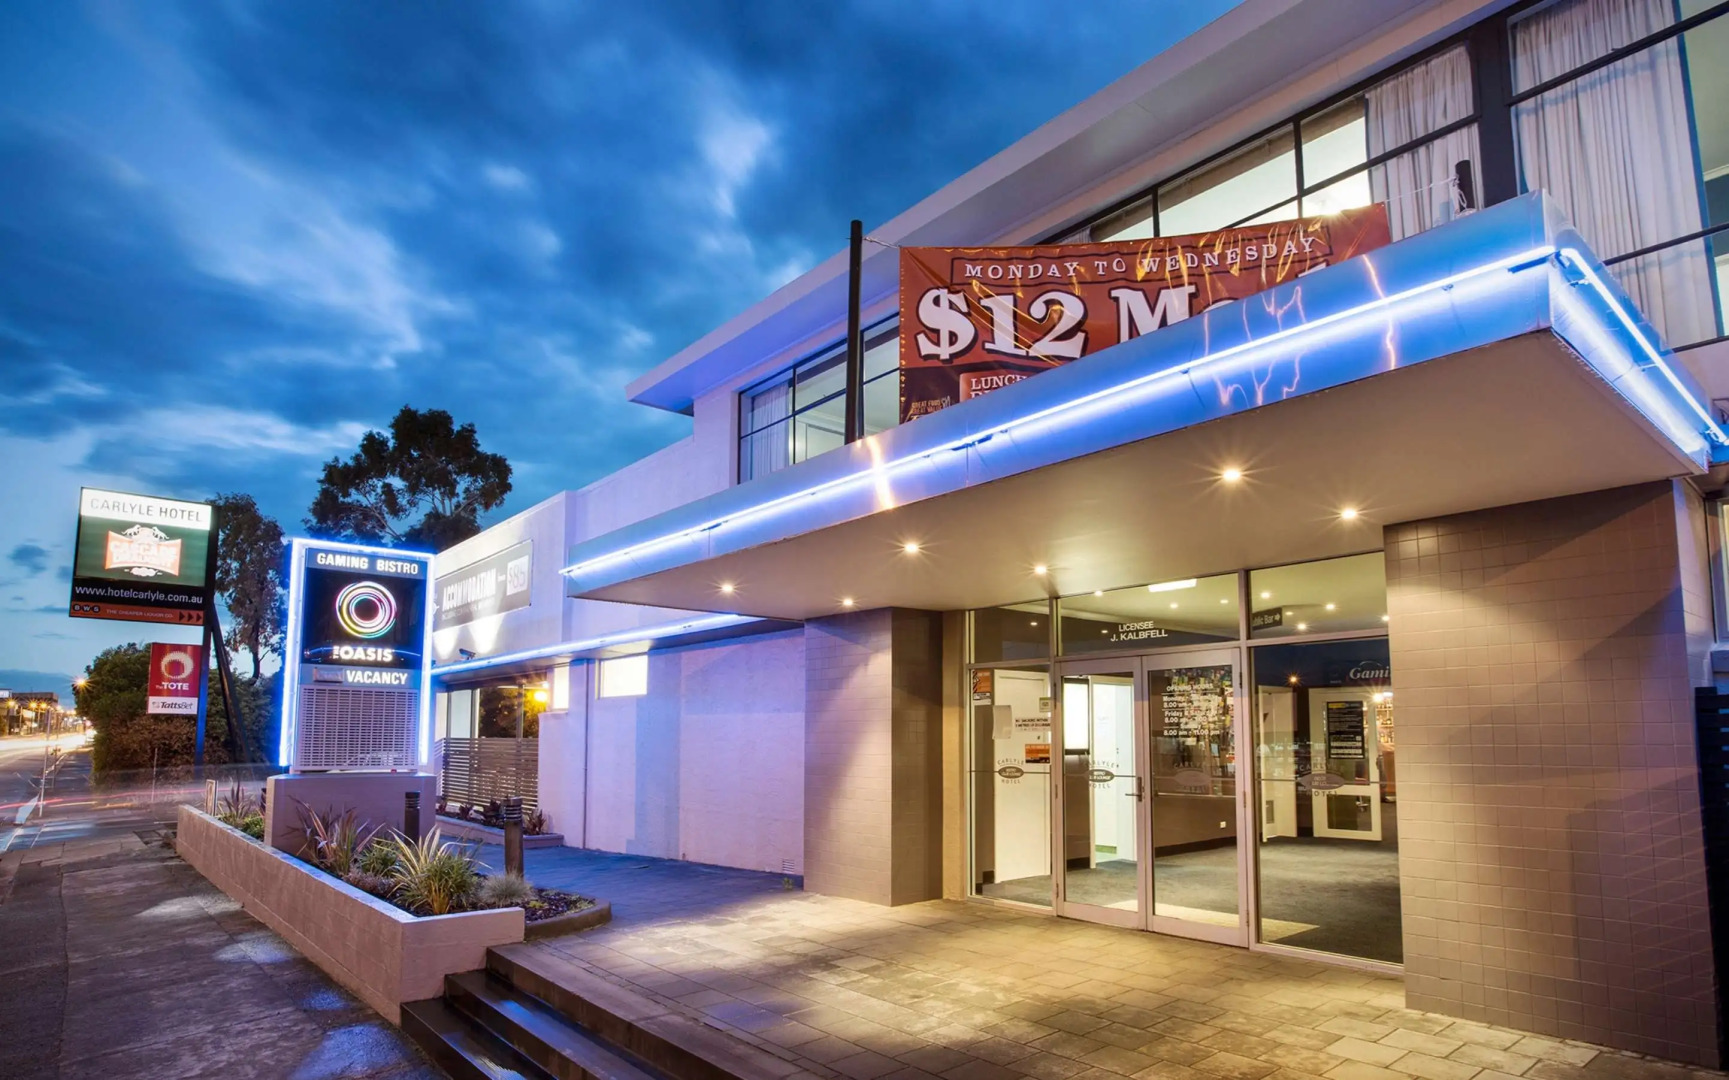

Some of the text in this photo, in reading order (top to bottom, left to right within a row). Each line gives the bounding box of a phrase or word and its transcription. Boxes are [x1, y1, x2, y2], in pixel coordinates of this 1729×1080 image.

[964, 236, 1315, 280] MONDAY TO WEDNESDAY
[915, 287, 1087, 361] $12
[90, 497, 202, 522] CARLYLE HOTEL
[317, 552, 418, 575] GAMING BISTRO
[75, 586, 203, 604] www.hotelcarlyle.com.au
[1118, 621, 1154, 632] LICENSEE
[1264, 614, 1274, 624] Bar
[1120, 629, 1169, 641] KALBFELL
[339, 645, 394, 662] OASIS
[346, 669, 408, 685] VACANCY
[1349, 666, 1390, 680] Gami
[162, 682, 189, 690] TOTE
[161, 702, 193, 710] TattsBet
